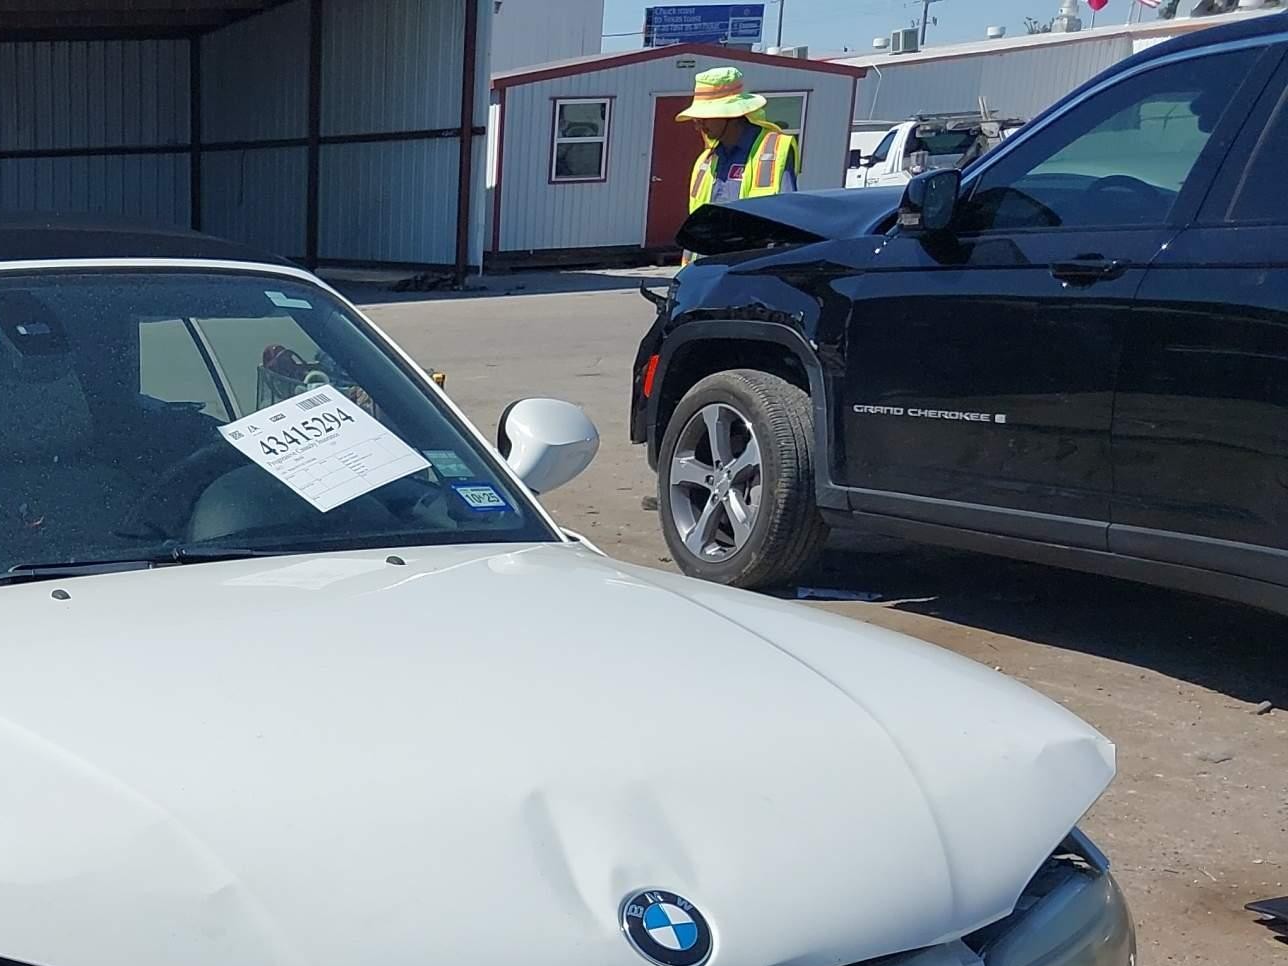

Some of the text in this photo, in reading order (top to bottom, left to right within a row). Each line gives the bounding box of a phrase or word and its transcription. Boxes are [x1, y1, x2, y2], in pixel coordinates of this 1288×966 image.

[853, 404, 904, 416] GRAND
[907, 408, 992, 422] CHEROKEE
[259, 407, 356, 456] 43415294
[627, 891, 694, 918] BMW
